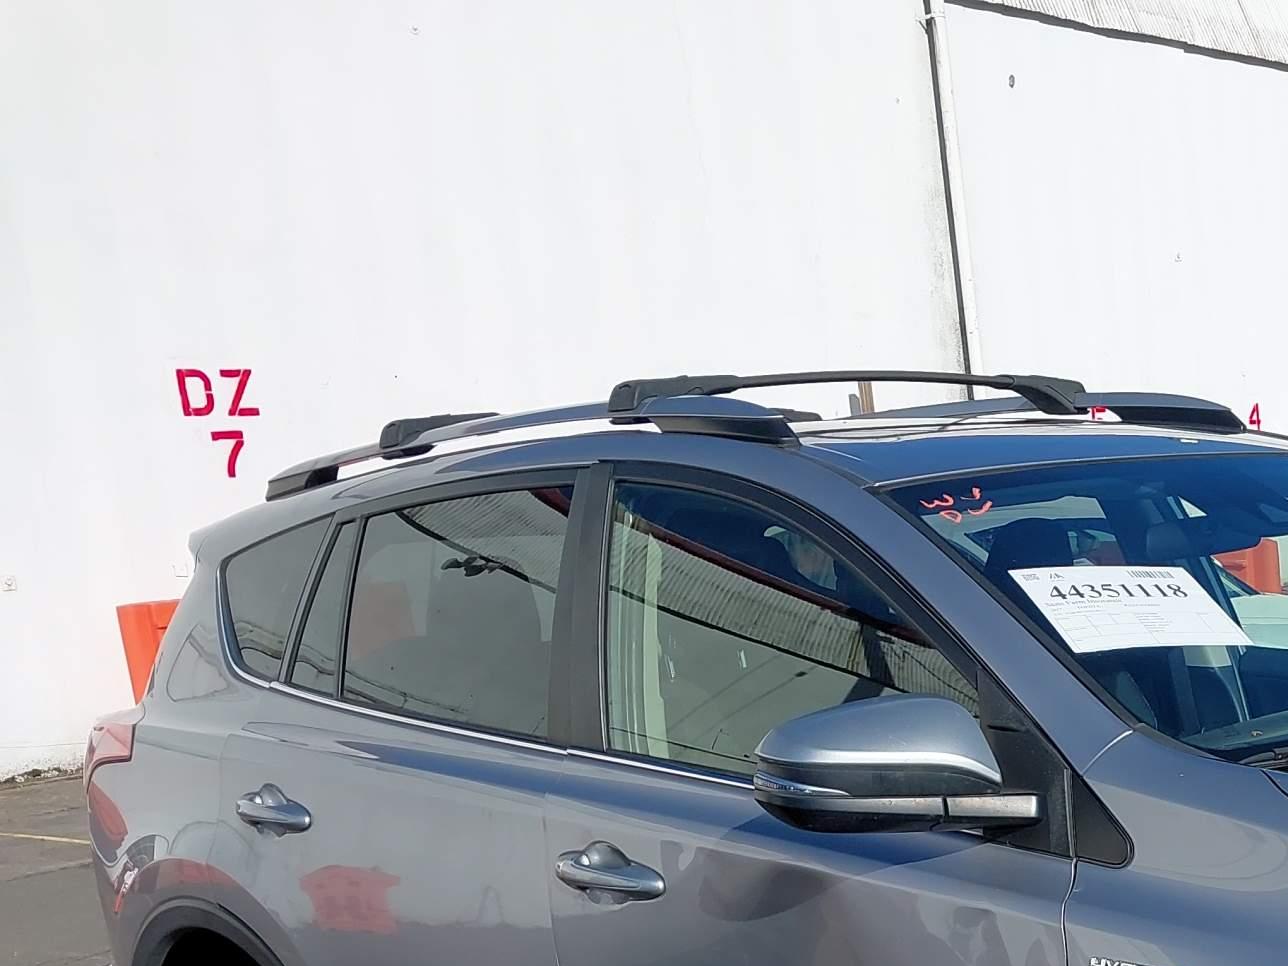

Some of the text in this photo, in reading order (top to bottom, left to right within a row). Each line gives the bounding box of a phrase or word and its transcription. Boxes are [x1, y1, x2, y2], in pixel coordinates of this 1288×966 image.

[176, 369, 260, 417] DZ
[1249, 403, 1262, 431] 4
[211, 430, 245, 479] 7
[1050, 583, 1188, 600] 44351118
